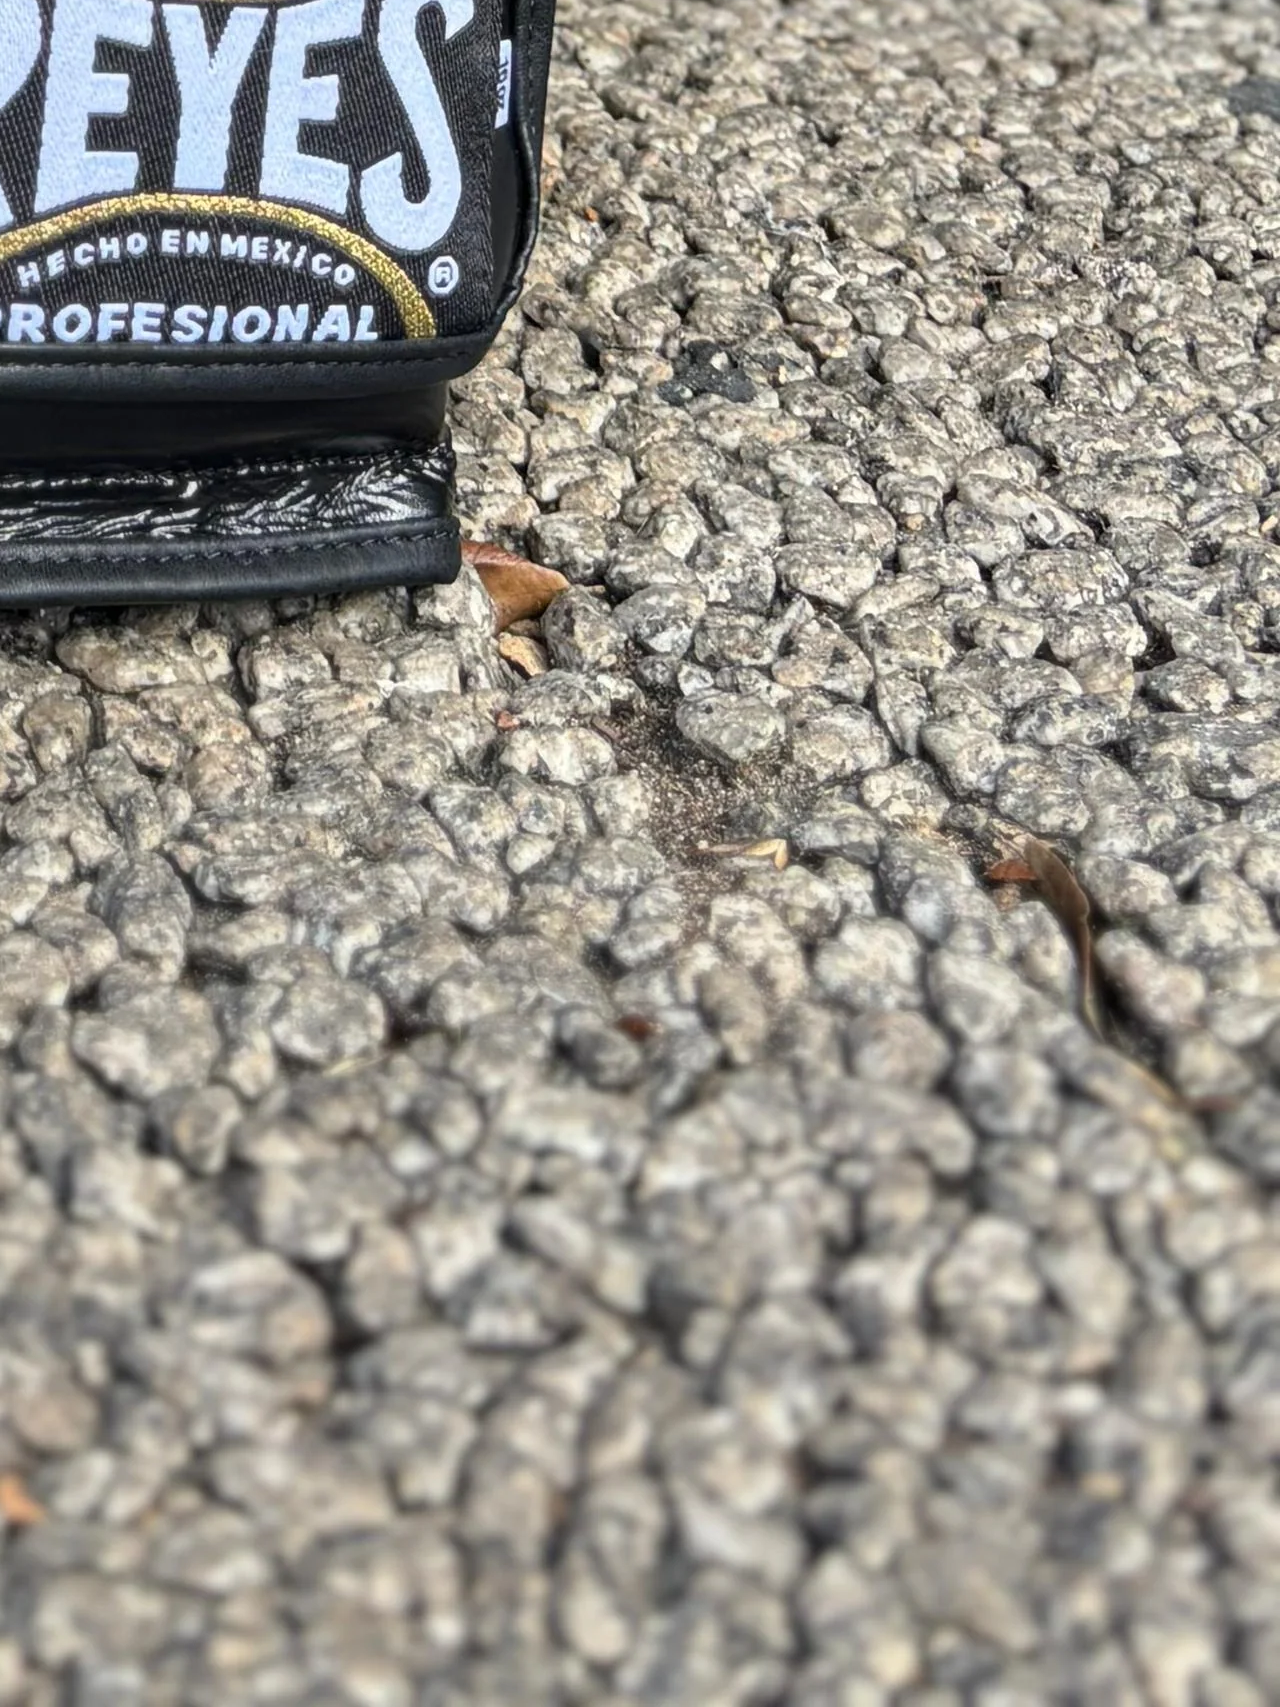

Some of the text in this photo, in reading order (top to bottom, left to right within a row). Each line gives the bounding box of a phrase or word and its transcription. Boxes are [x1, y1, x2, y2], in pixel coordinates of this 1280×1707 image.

[18, 228, 355, 288] HECHO EN MEXICO
